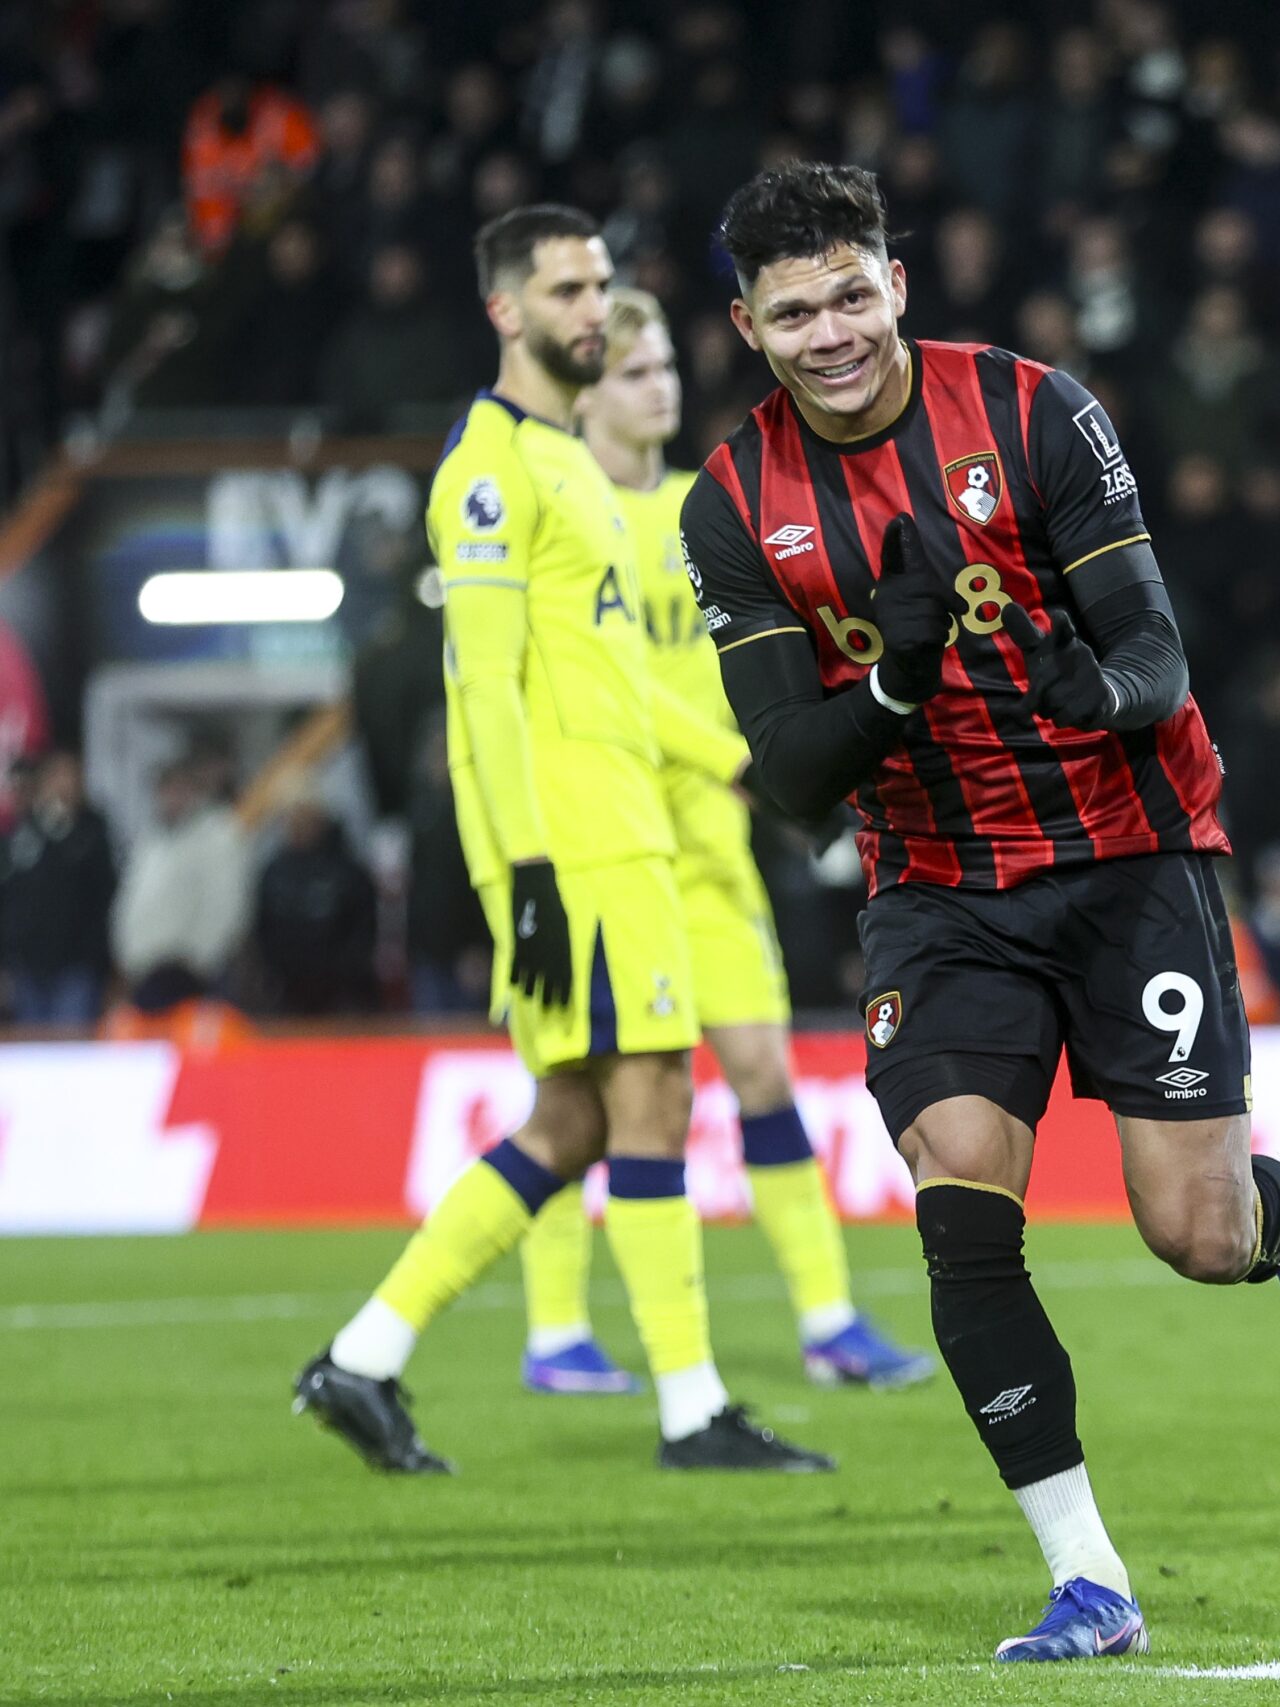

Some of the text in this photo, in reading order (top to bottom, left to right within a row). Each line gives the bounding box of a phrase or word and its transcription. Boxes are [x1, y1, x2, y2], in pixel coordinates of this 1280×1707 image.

[774, 541, 814, 561] umbro
[1141, 970, 1204, 1063] 9
[1164, 1087, 1208, 1099] umbro
[988, 1396, 1037, 1425] umbro
